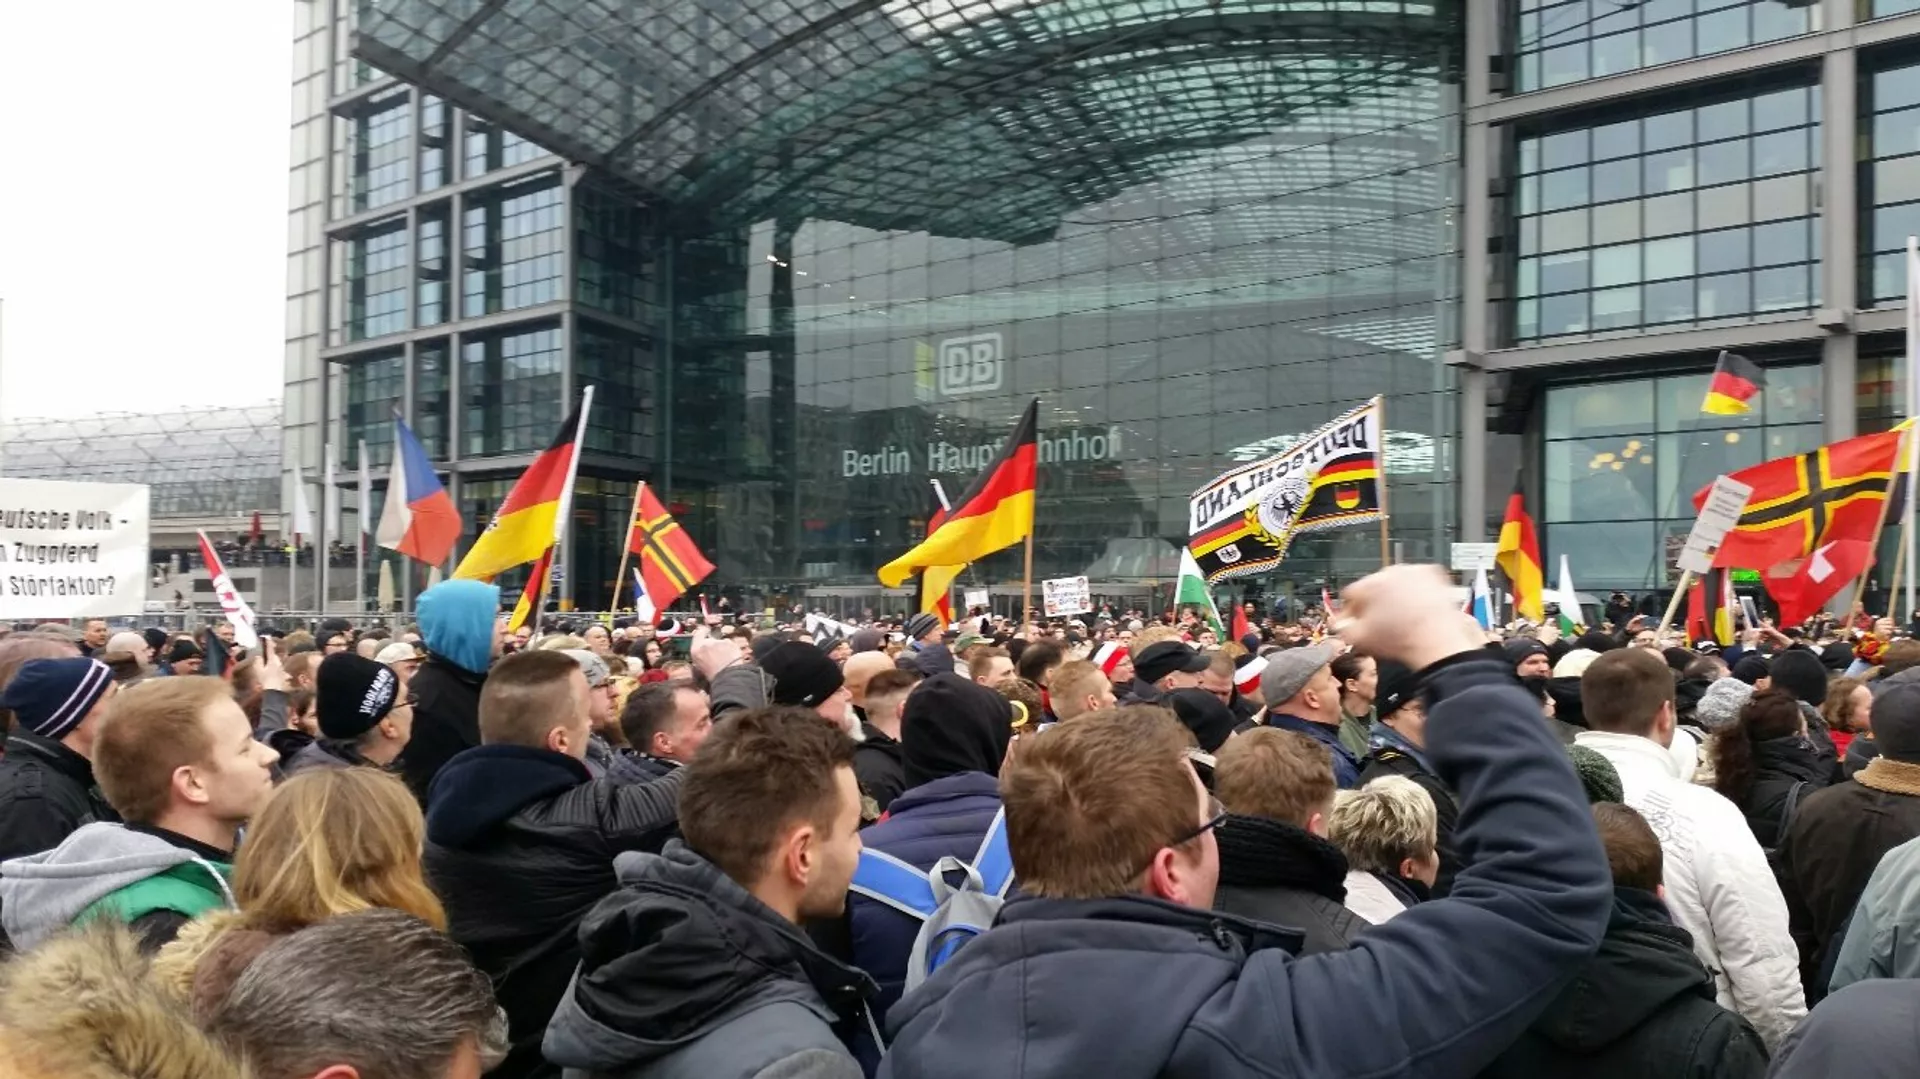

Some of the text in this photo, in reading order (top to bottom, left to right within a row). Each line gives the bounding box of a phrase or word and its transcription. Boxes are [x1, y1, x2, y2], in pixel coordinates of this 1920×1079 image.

[947, 343, 994, 385] DB
[843, 425, 1119, 478] Berlin Haupthnhof
[76, 509, 112, 531] Volk
[14, 541, 100, 565] Zugpferd
[9, 574, 116, 597] Störfaktor?
